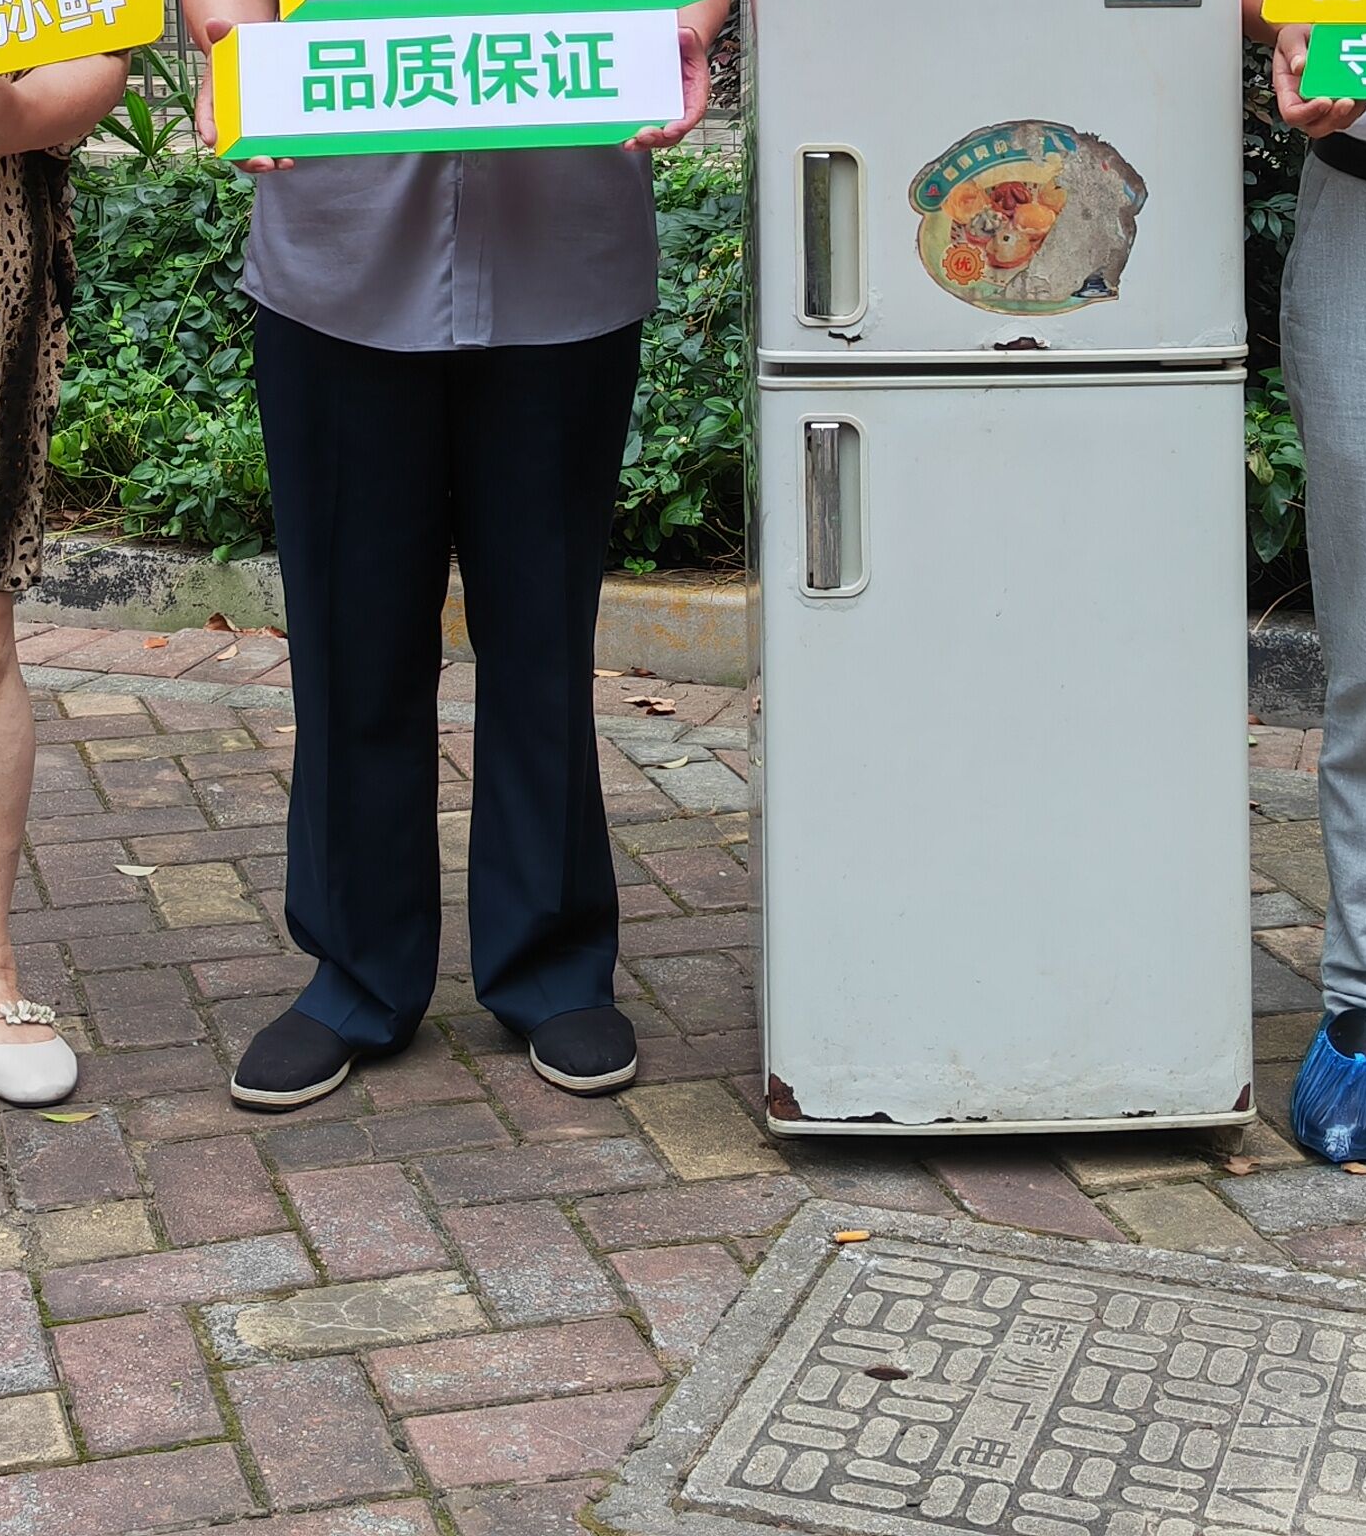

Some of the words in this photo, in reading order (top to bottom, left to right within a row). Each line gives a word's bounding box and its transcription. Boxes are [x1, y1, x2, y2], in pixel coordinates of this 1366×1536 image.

[301, 30, 619, 112] 品质保证
[953, 255, 972, 273] 优
[1216, 1365, 1328, 1519] CATV
